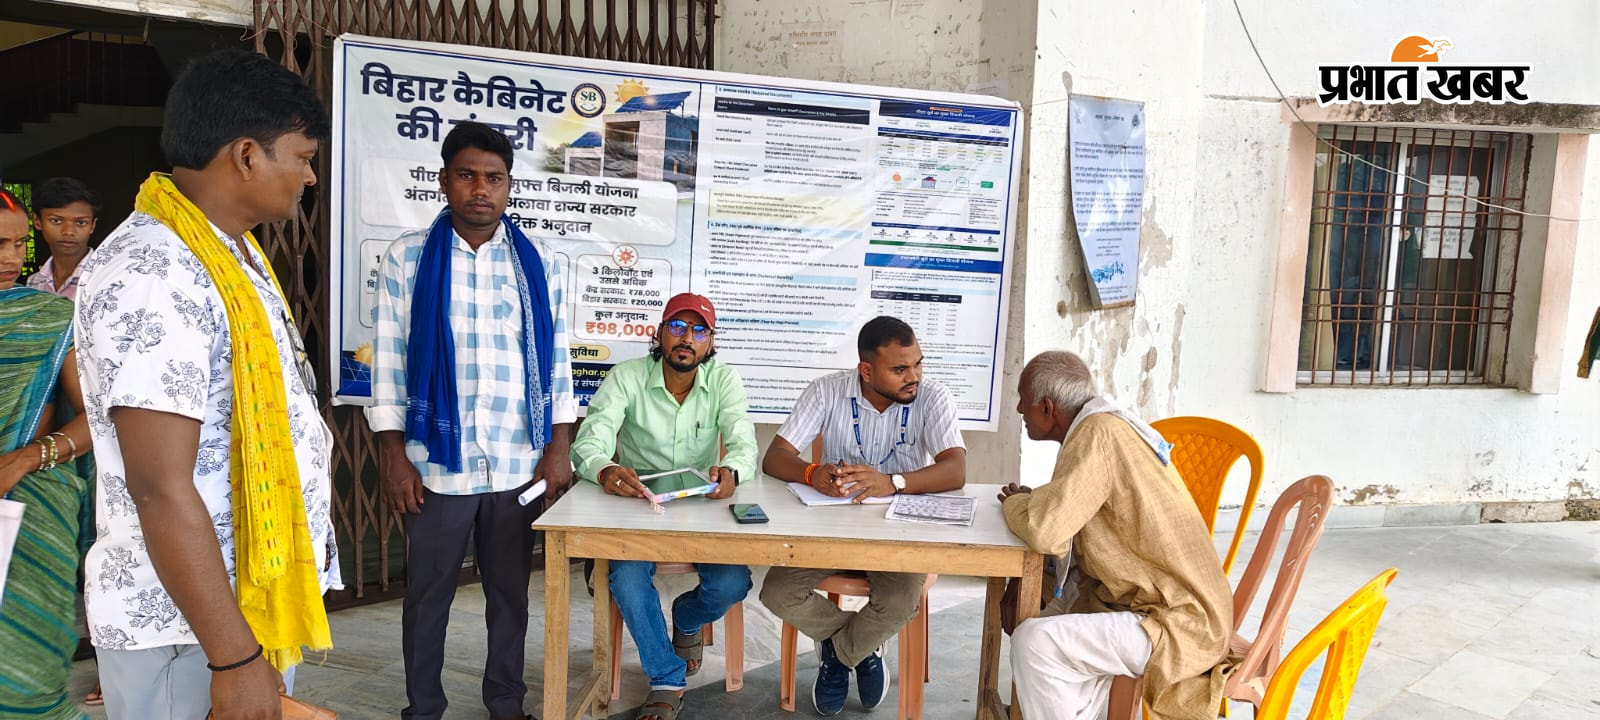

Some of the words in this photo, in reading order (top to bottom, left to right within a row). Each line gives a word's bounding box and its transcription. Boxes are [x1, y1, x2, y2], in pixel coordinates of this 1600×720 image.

[360, 62, 448, 104] बिहार
[452, 70, 567, 114] कैबिनेट
[396, 106, 443, 142] की
[409, 166, 441, 182] पीए
[547, 177, 592, 196] बिजली
[594, 182, 640, 199] योजना
[507, 197, 552, 211] अलावा
[554, 200, 587, 214] राज्य
[590, 203, 637, 217] सरकार
[541, 219, 593, 236] अनुदान
[592, 266, 599, 275] 3
[640, 268, 653, 278] एवं
[599, 276, 620, 285] उससे
[622, 277, 647, 287] अधिक
[631, 299, 663, 307] ₹20,000
[594, 310, 613, 321] कुल
[615, 312, 648, 322] अनुदान:
[585, 321, 656, 337] ₹98,000
